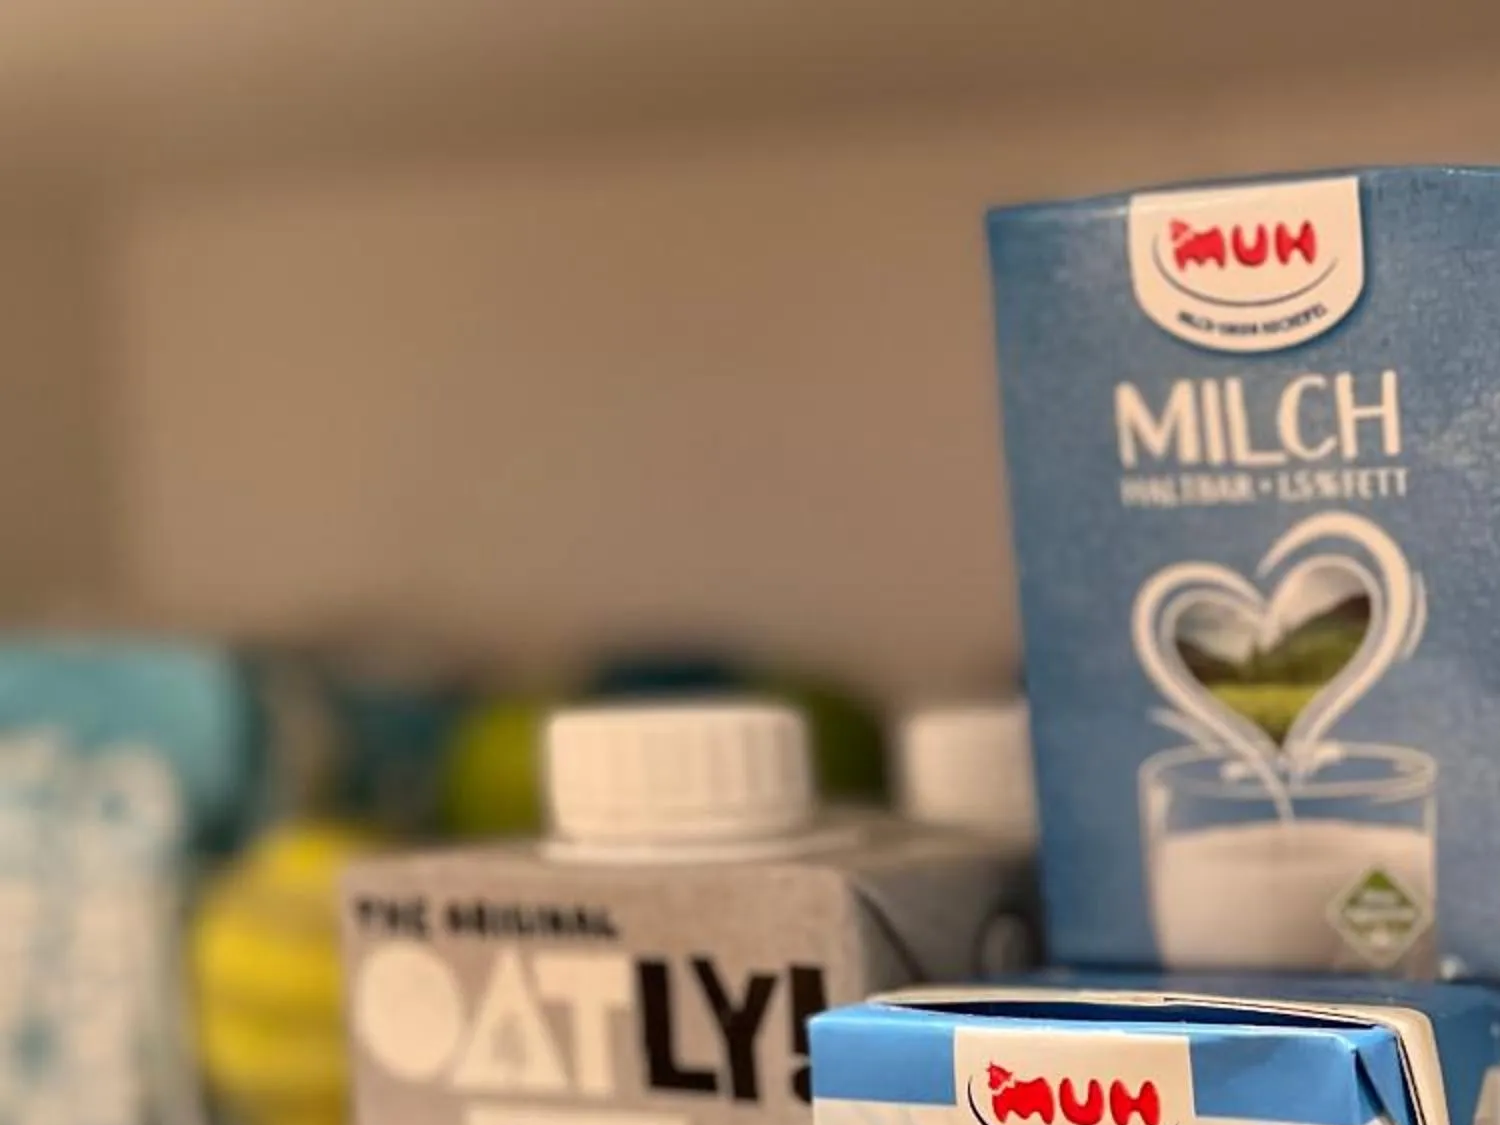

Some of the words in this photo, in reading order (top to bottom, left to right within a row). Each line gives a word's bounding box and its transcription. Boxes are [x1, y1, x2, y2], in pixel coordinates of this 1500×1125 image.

[1169, 218, 1317, 271] MUH
[1115, 369, 1402, 468] MILCH
[355, 898, 427, 939] THE
[445, 901, 619, 940] ORIGINAL
